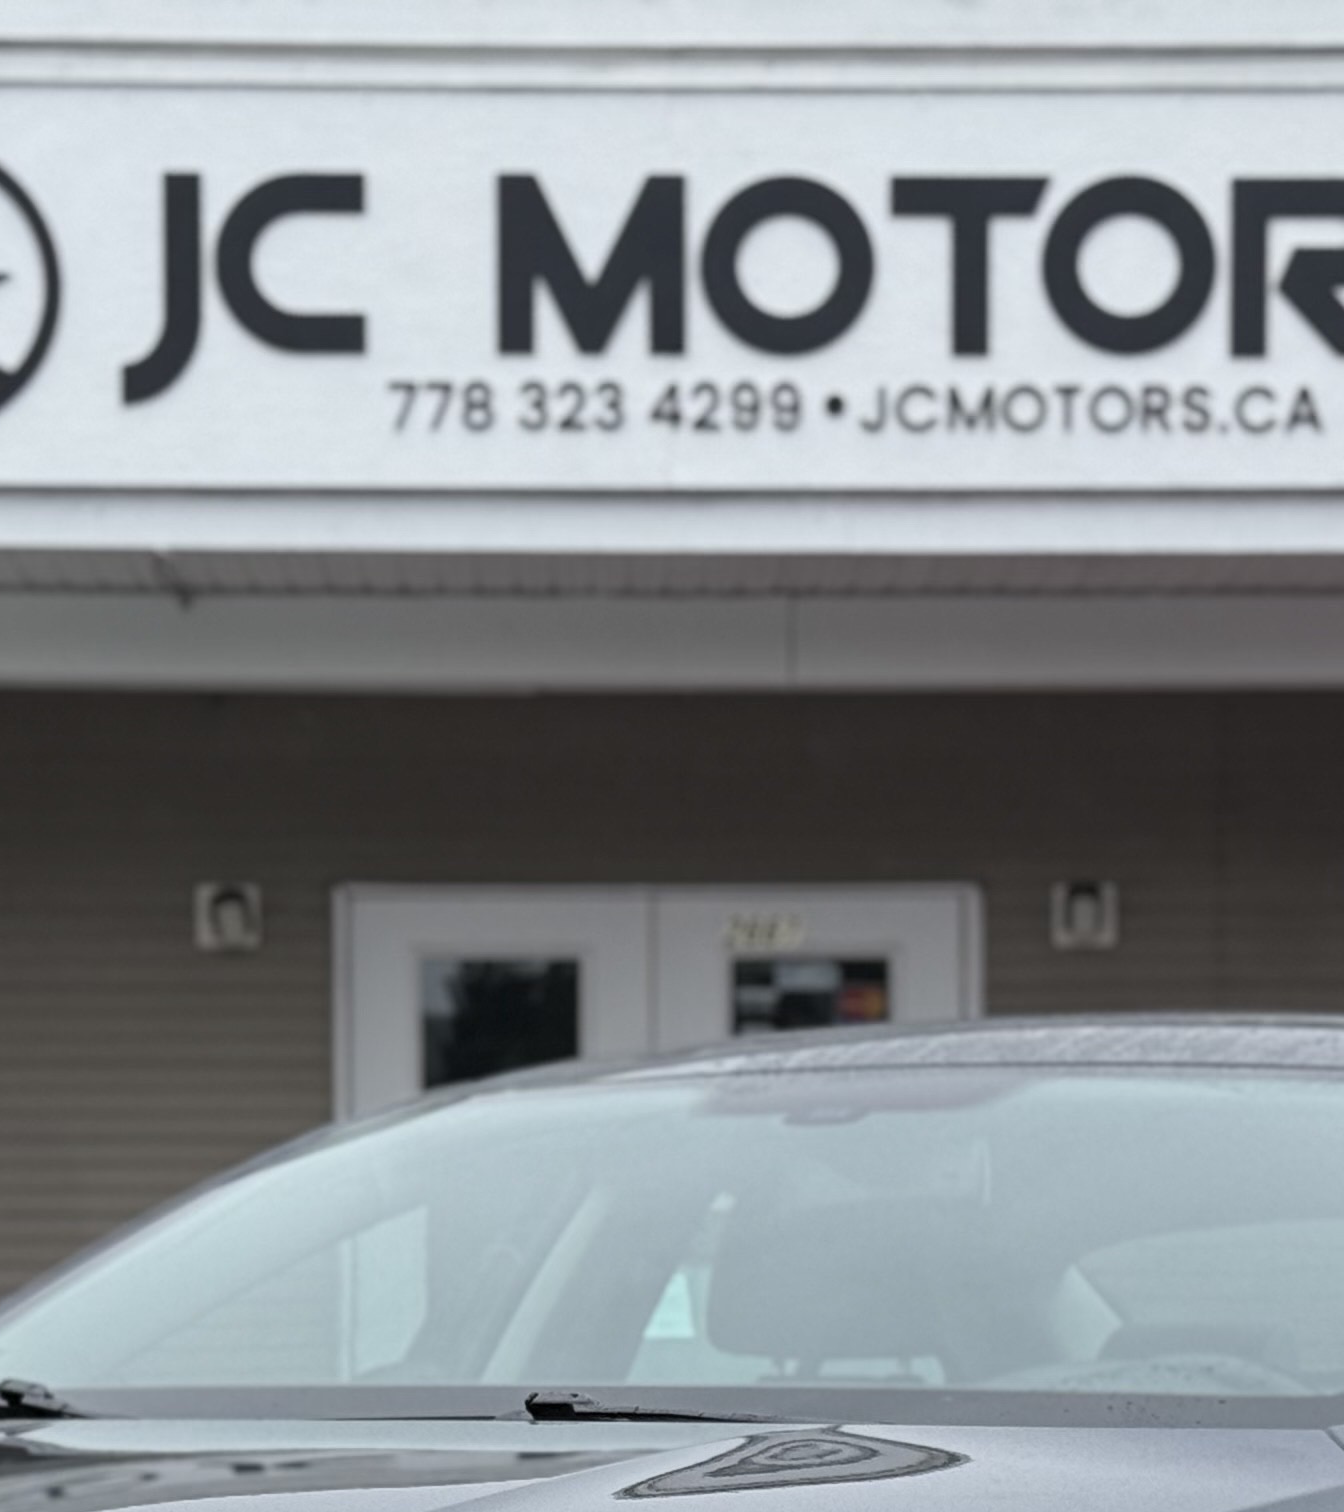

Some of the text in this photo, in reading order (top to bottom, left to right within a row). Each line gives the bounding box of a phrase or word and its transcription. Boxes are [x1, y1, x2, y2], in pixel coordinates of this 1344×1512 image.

[121, 172, 367, 407] JC
[391, 382, 493, 432] 778
[522, 382, 623, 432] 323
[650, 382, 802, 432] 4299
